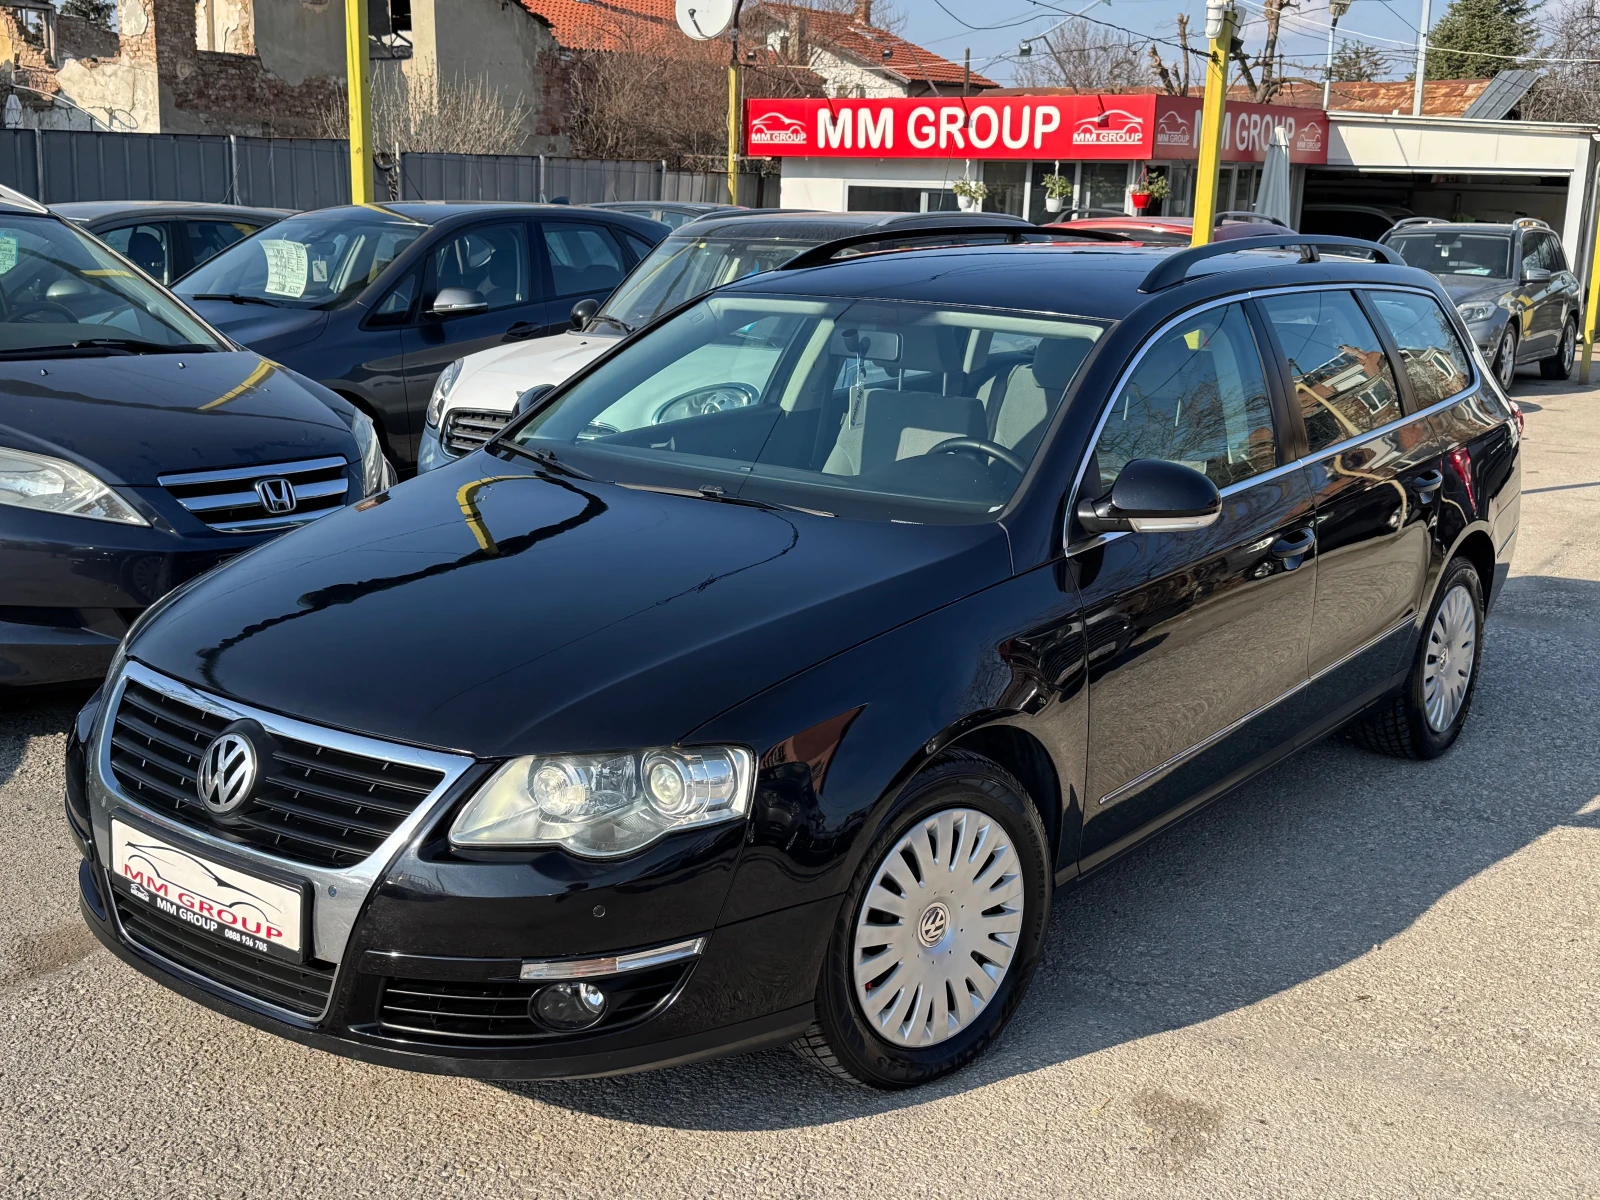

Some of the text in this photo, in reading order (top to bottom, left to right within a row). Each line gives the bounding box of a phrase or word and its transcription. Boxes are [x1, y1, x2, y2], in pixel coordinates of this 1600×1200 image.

[751, 132, 806, 142] MM GROUP
[816, 105, 1061, 150] MM GROUP
[1072, 132, 1143, 142] MM GROUP
[1157, 133, 1190, 143] MM GROUP
[1297, 141, 1321, 150] MM GROUP
[1022, 819, 1045, 942] 215/55R16 97V
[124, 863, 169, 898] MM
[178, 892, 283, 940] GROUP
[157, 897, 177, 916] MM
[179, 908, 218, 932] GROUP
[224, 928, 241, 943] 0888
[241, 935, 254, 947] 936
[254, 940, 268, 953] 705
